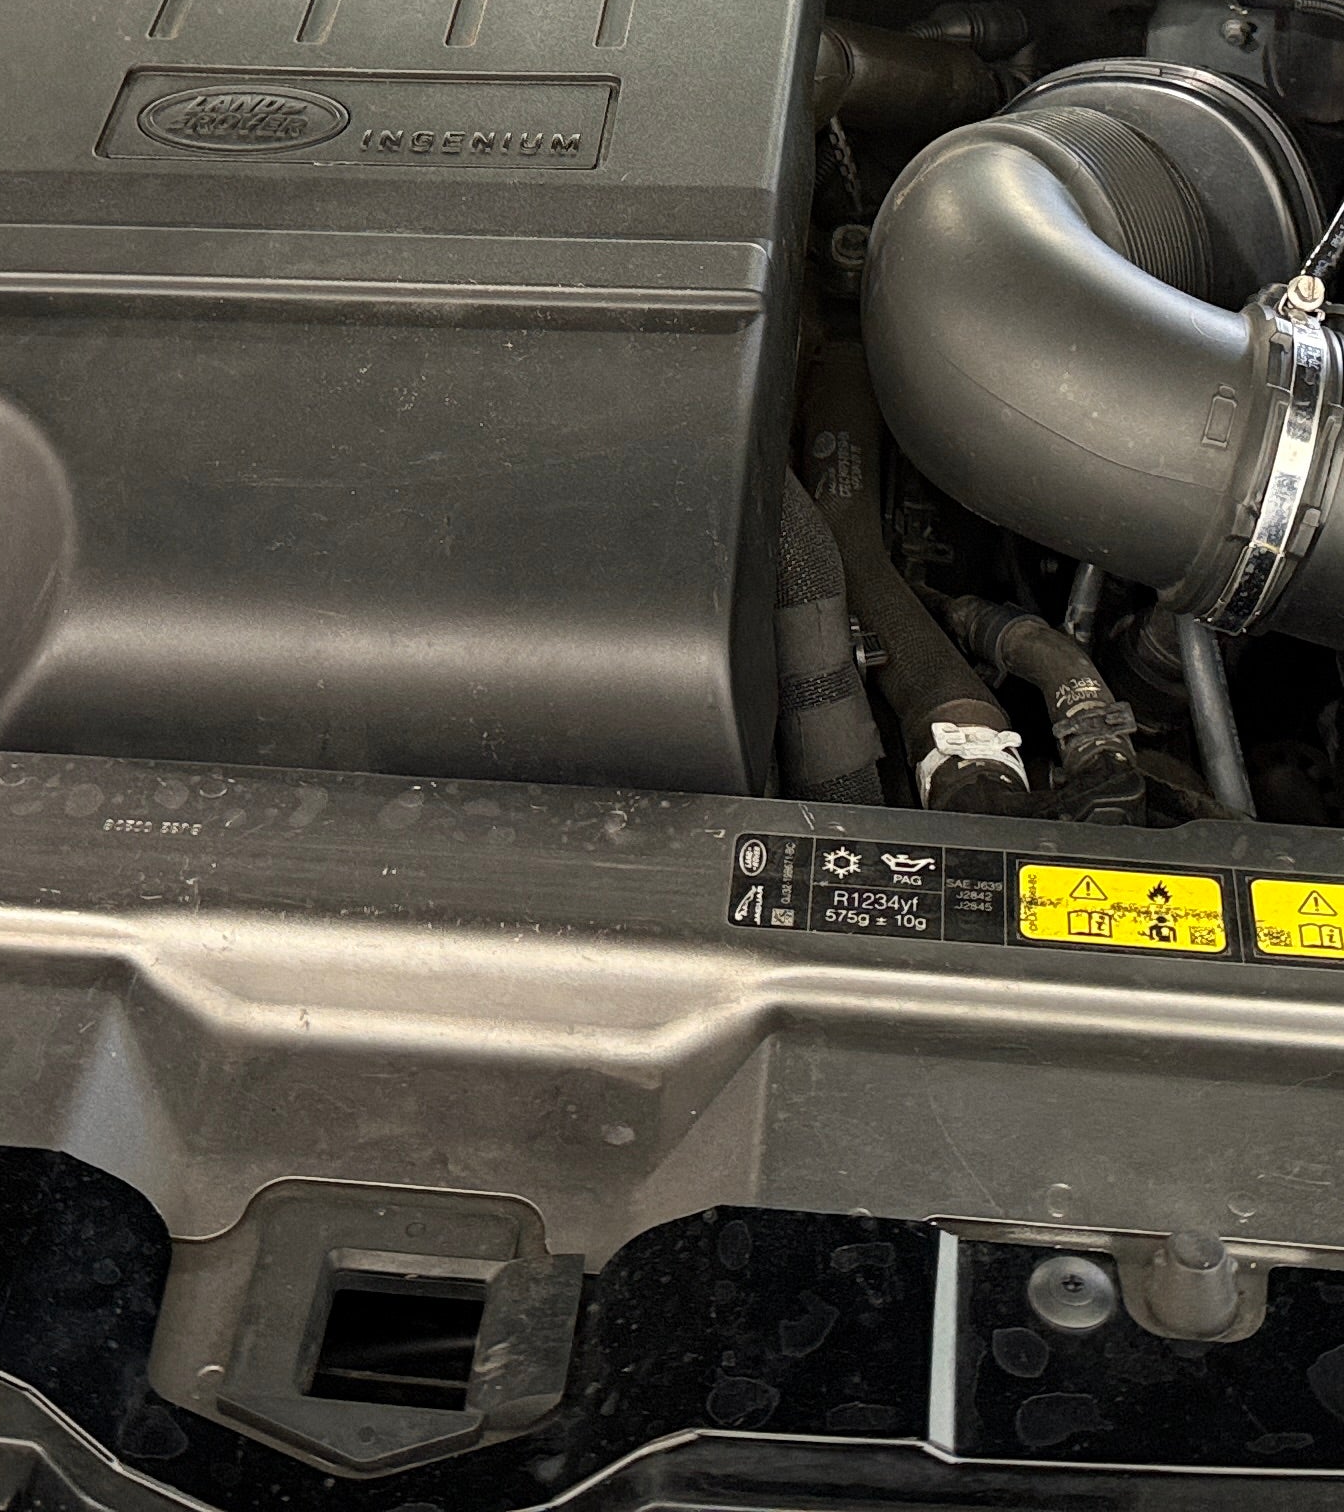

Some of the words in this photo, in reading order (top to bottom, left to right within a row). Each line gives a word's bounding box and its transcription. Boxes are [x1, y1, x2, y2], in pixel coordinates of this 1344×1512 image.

[187, 95, 286, 113] LAND
[184, 113, 309, 137] ROVER
[359, 128, 582, 155] INGENIUM
[893, 874, 922, 886] PAG
[946, 879, 970, 889] SAE
[973, 881, 1003, 892] J639
[754, 885, 764, 925] JAGUAR
[833, 890, 919, 914] R1234yf
[954, 901, 993, 912] J2845
[955, 891, 993, 902] J2842
[824, 908, 871, 927] 575g
[875, 916, 888, 927] ±
[895, 914, 927, 931] 10g
